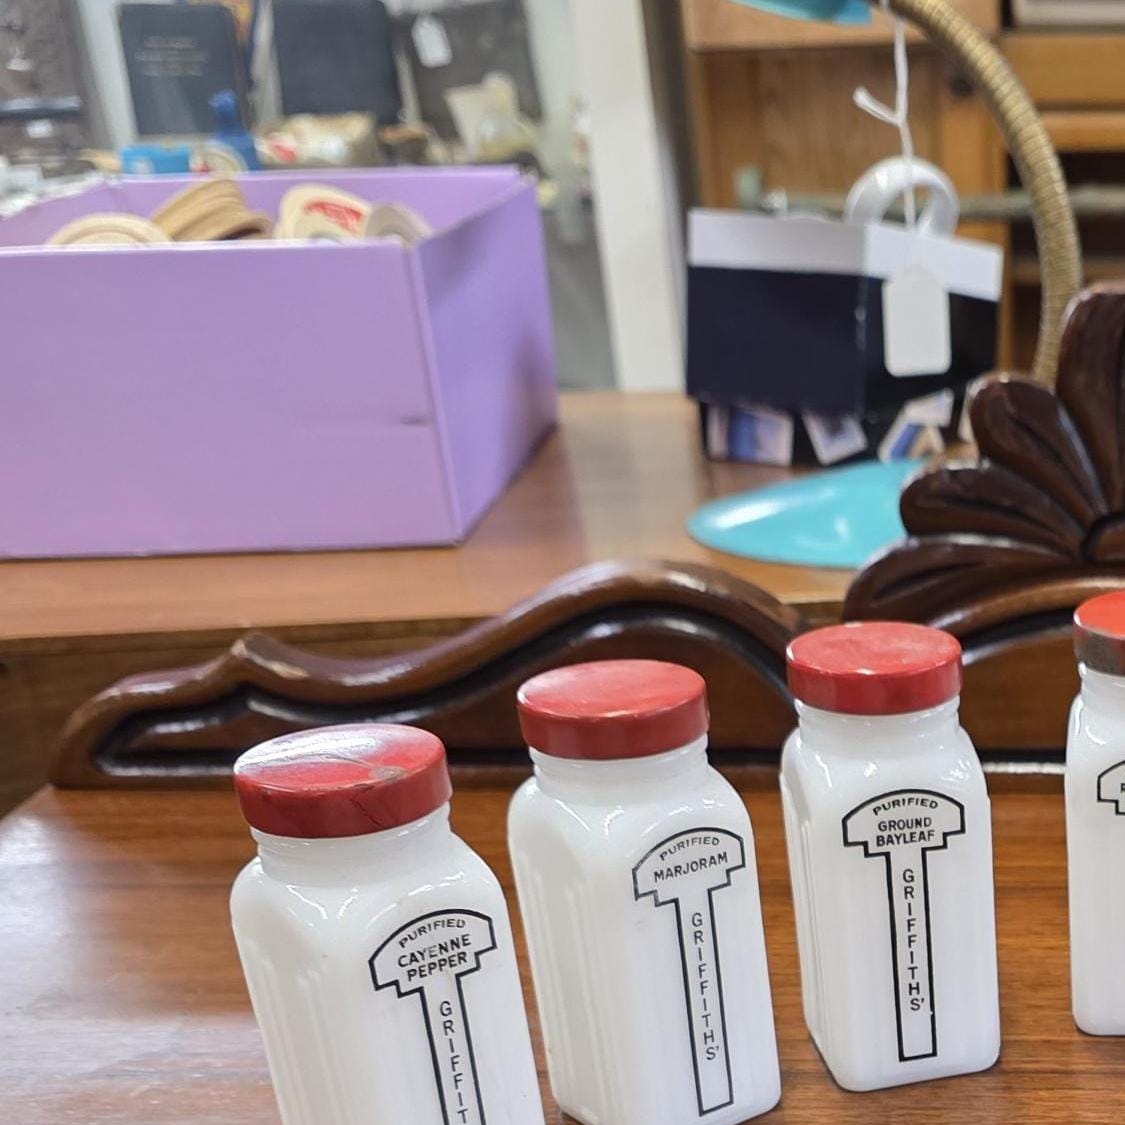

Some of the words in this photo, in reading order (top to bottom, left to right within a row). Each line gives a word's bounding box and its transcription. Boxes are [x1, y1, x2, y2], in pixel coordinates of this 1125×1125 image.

[872, 797, 939, 816] PURIFIED
[877, 816, 932, 832] GROUND
[659, 836, 721, 862] PURIFIED
[876, 829, 935, 848] BAYLEAF
[653, 851, 729, 883] MARJORAM
[398, 918, 466, 949] PURIFIED
[397, 934, 472, 968] CAYENNE
[407, 951, 468, 982] PEPPER
